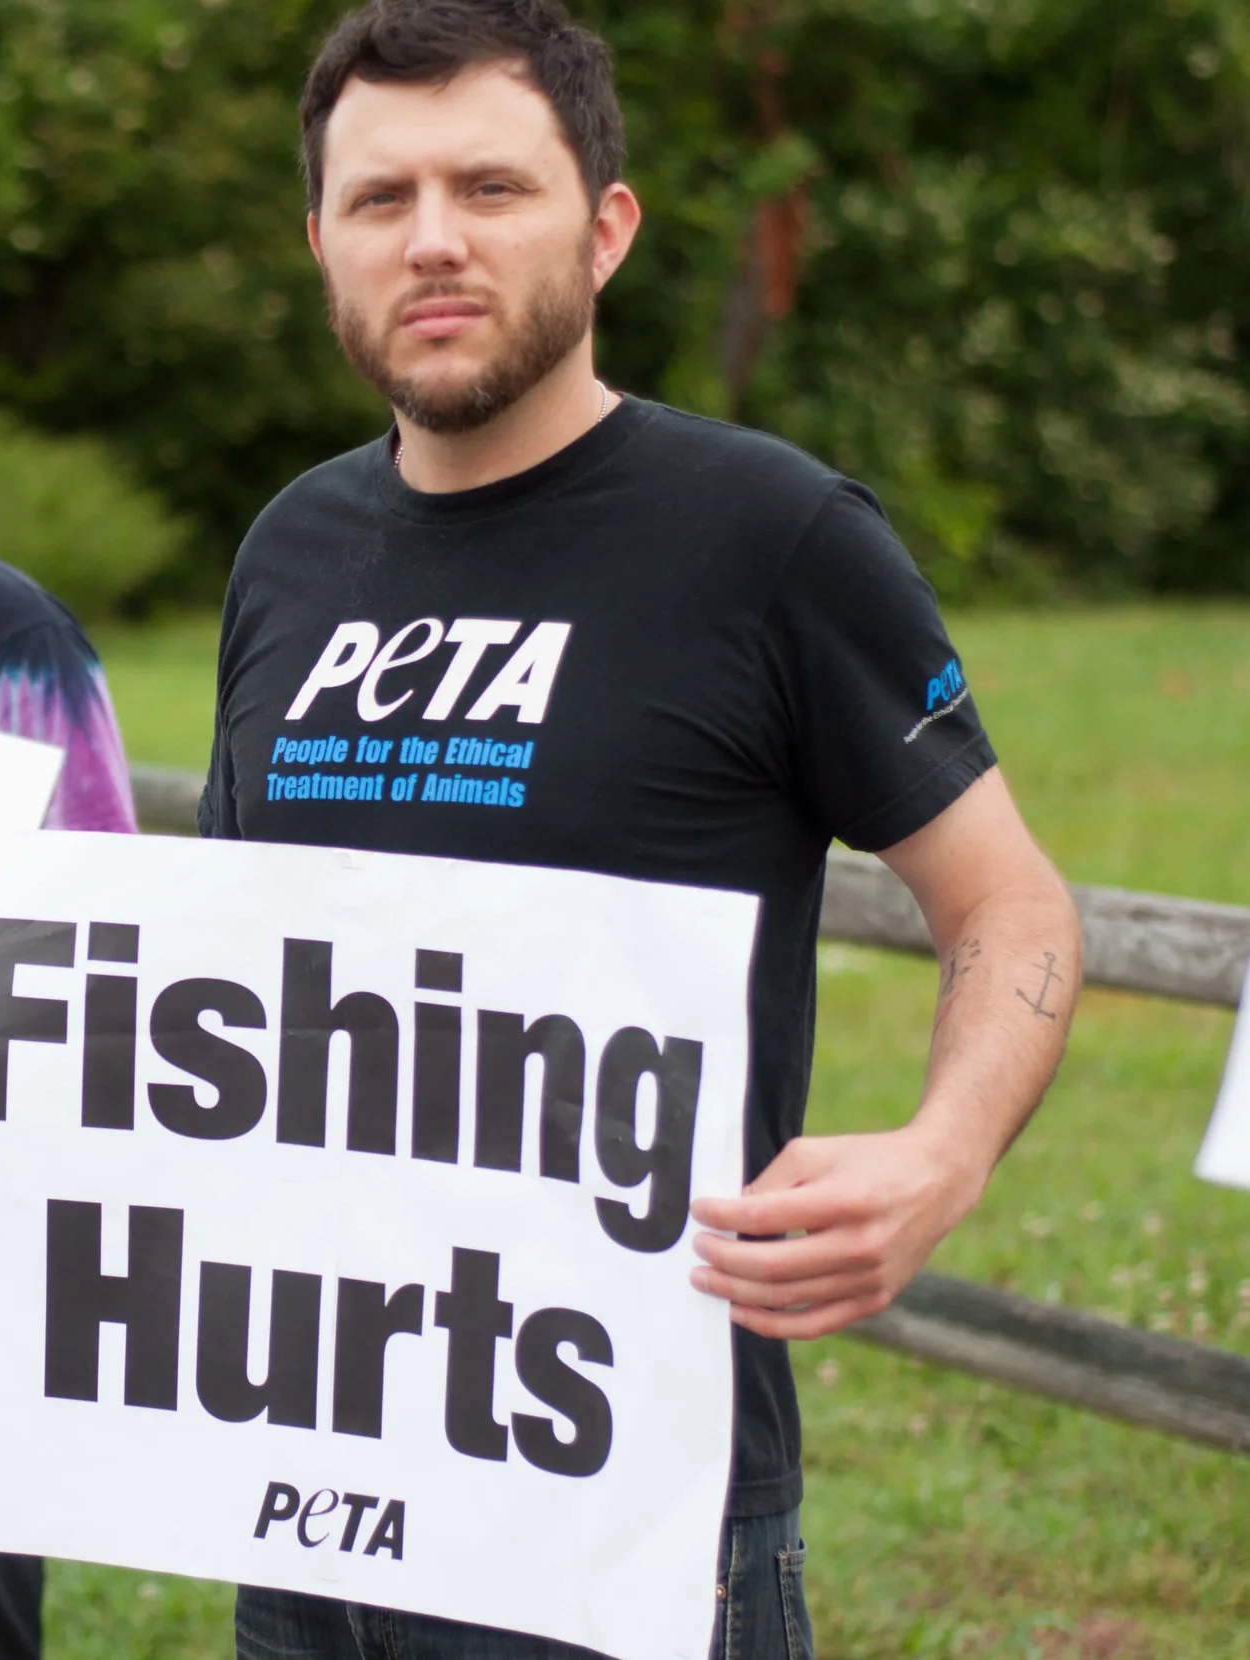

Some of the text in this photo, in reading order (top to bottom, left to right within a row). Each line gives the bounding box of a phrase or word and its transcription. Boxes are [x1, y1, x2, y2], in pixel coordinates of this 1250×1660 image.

[271, 735, 534, 769] People for the Ethical
[267, 772, 526, 807] Treatment of Animals
[44, 1198, 615, 1479] Hurts
